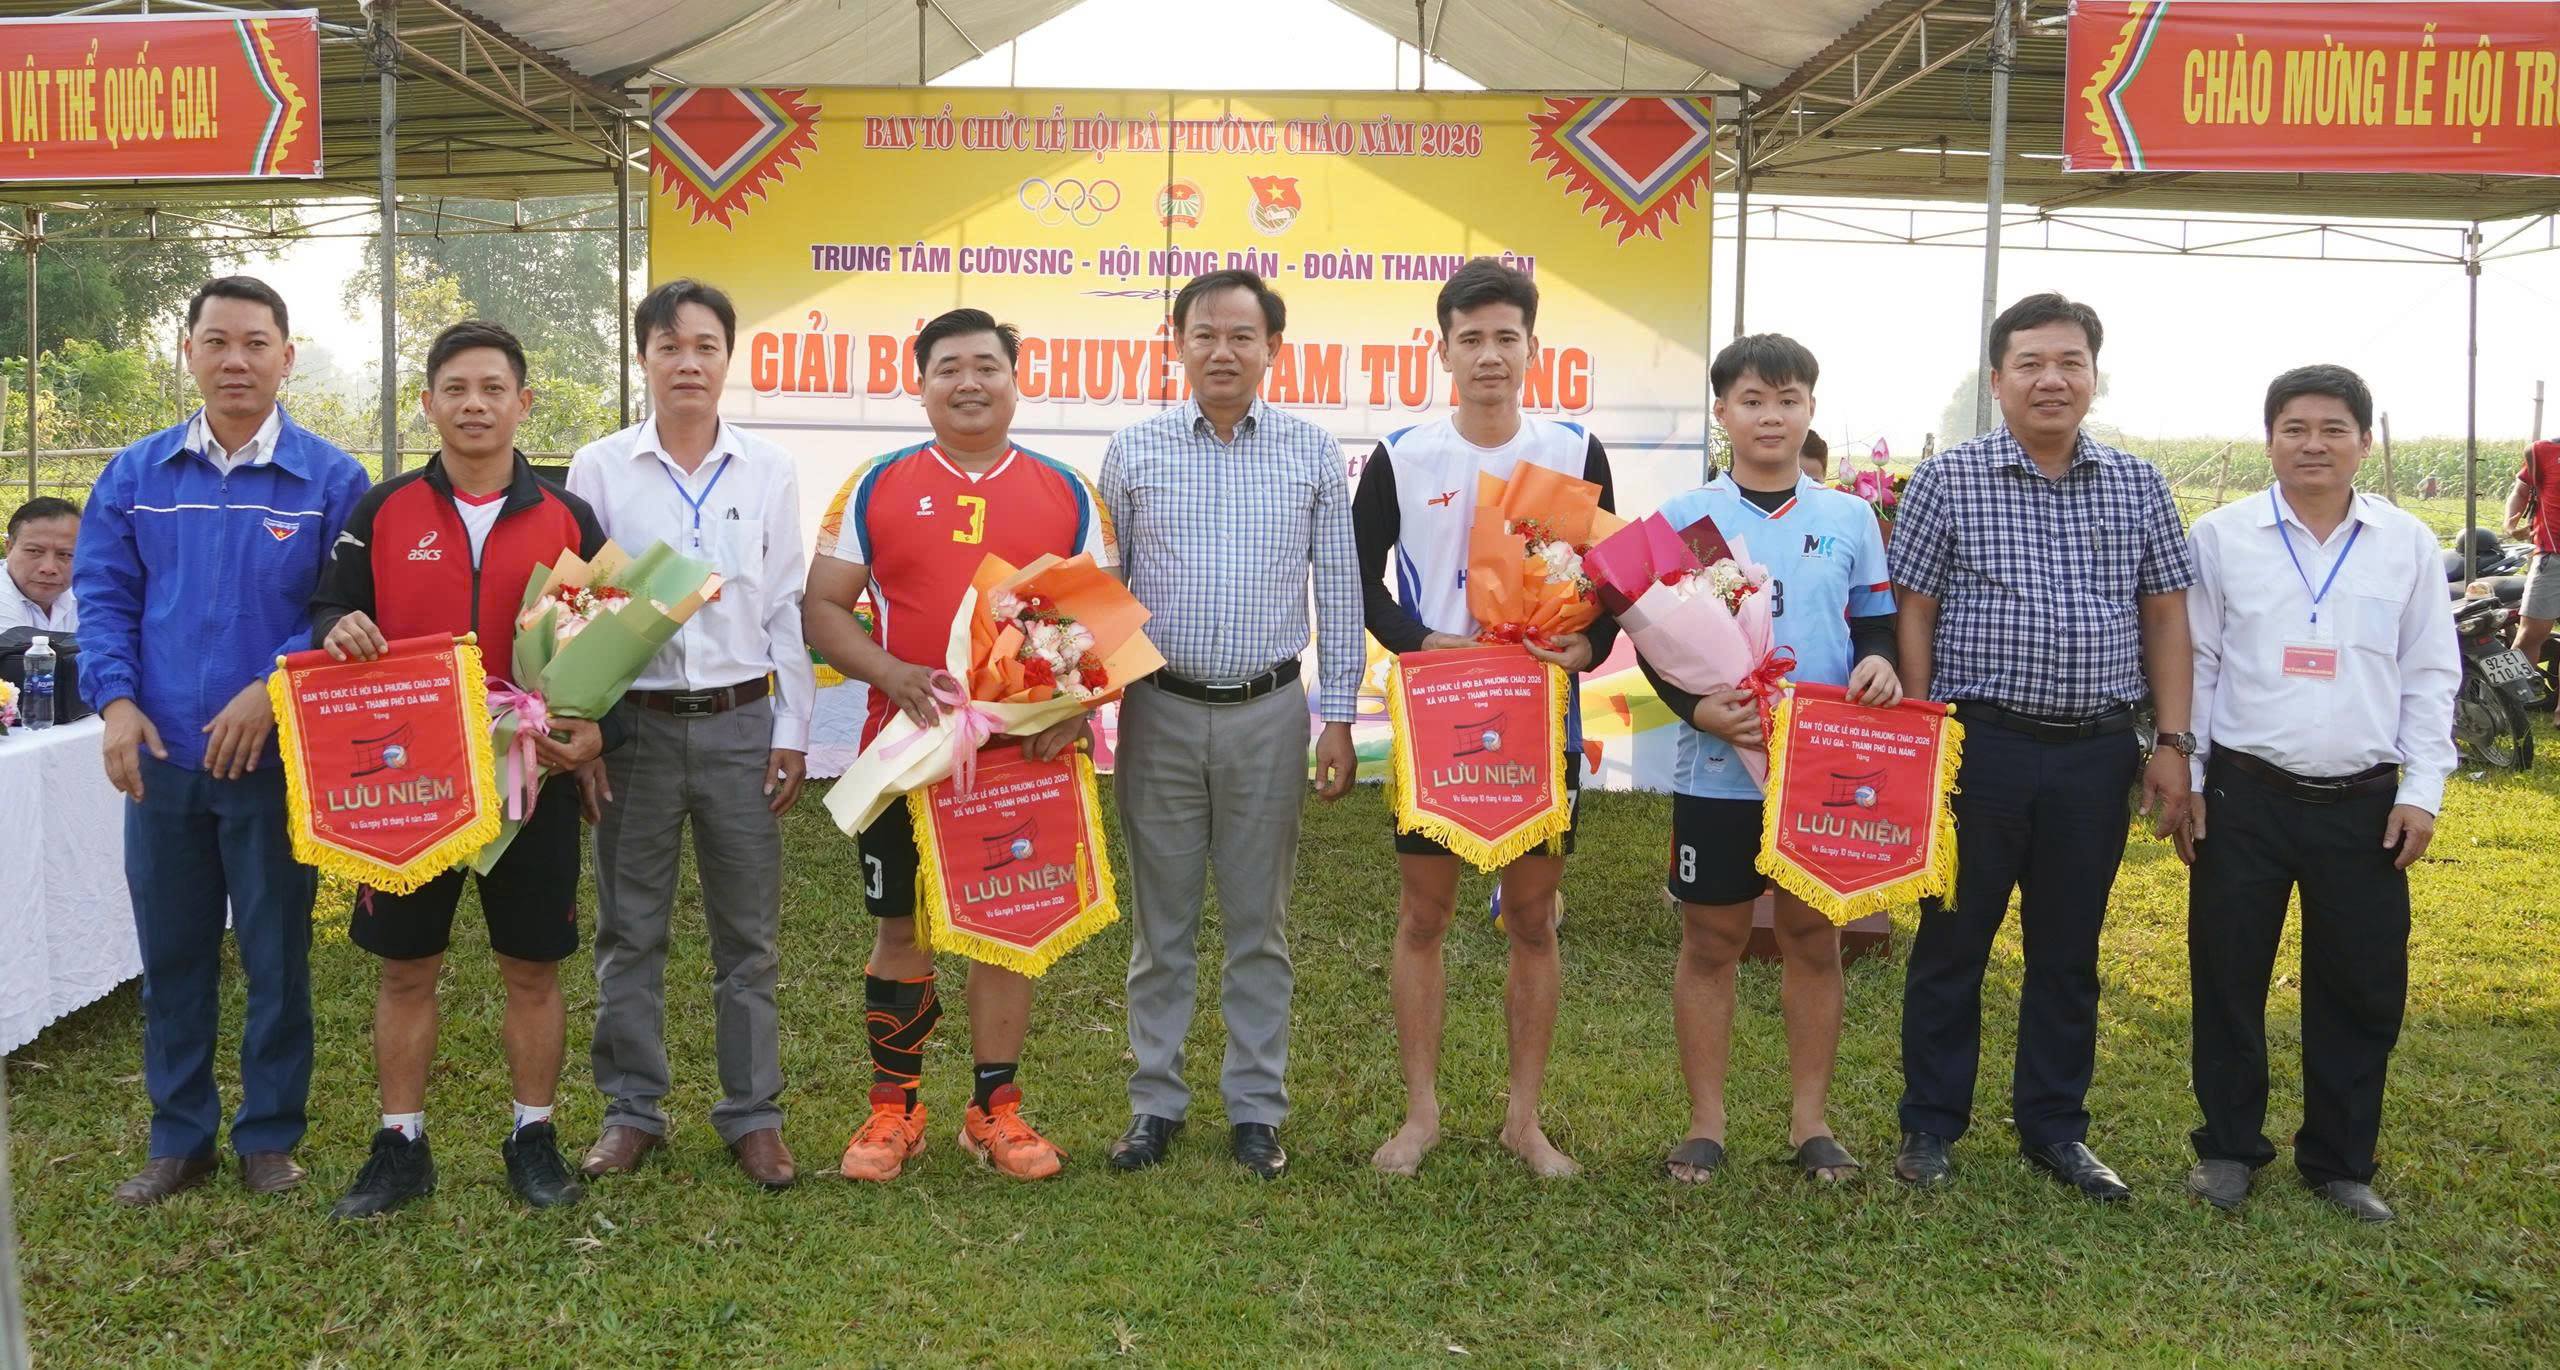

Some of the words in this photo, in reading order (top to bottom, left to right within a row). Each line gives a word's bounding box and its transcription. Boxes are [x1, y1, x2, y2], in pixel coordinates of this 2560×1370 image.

[9, 54, 50, 159] VẬT
[56, 38, 97, 141] THỂ
[104, 41, 164, 149] QUỐC
[172, 66, 218, 140] GIA!
[2183, 34, 2273, 125] CHÀO
[2283, 34, 2386, 126] MỪNG
[2395, 22, 2436, 126] LỄ
[2445, 34, 2505, 144] HỘI
[865, 116, 918, 149] BAN
[920, 104, 956, 149] TỔ
[961, 110, 1029, 151] CHỨC
[1034, 104, 1067, 152] LỄ
[1072, 112, 1122, 162] HỘI
[1127, 112, 1164, 152] BÀ
[1169, 112, 1278, 154] PHƯỜNG
[1284, 114, 1355, 156] CHÀO
[1359, 114, 1417, 156] NĂM
[1420, 122, 1483, 157] 2026
[812, 245, 891, 272] TRUNG
[899, 241, 951, 273] TÂM
[1100, 245, 1140, 282] HỘI
[1150, 246, 1218, 278] NÔNG
[1227, 247, 1278, 278] DÂN
[1303, 249, 1376, 280] ĐOÀN
[1382, 255, 1465, 282] THANH
[751, 310, 850, 394] GIẢI
[1362, 327, 1437, 408] TỨ
[953, 495, 986, 544] 3
[408, 549, 442, 561] asics
[2485, 651, 2520, 671] 92-E1
[302, 693, 317, 703] BAN
[1799, 720, 1812, 730] BAN
[327, 783, 381, 812] LƯU
[388, 775, 455, 807] NIỆM
[1433, 761, 1480, 788] LƯU
[1485, 760, 1537, 788] NIỆM
[1796, 812, 1846, 838] LƯU
[1851, 818, 1913, 847] NIỆM
[865, 854, 883, 899] 3
[1680, 844, 1696, 883] 8
[963, 876, 1012, 905] LƯU
[1018, 863, 1076, 894] NIỆM
